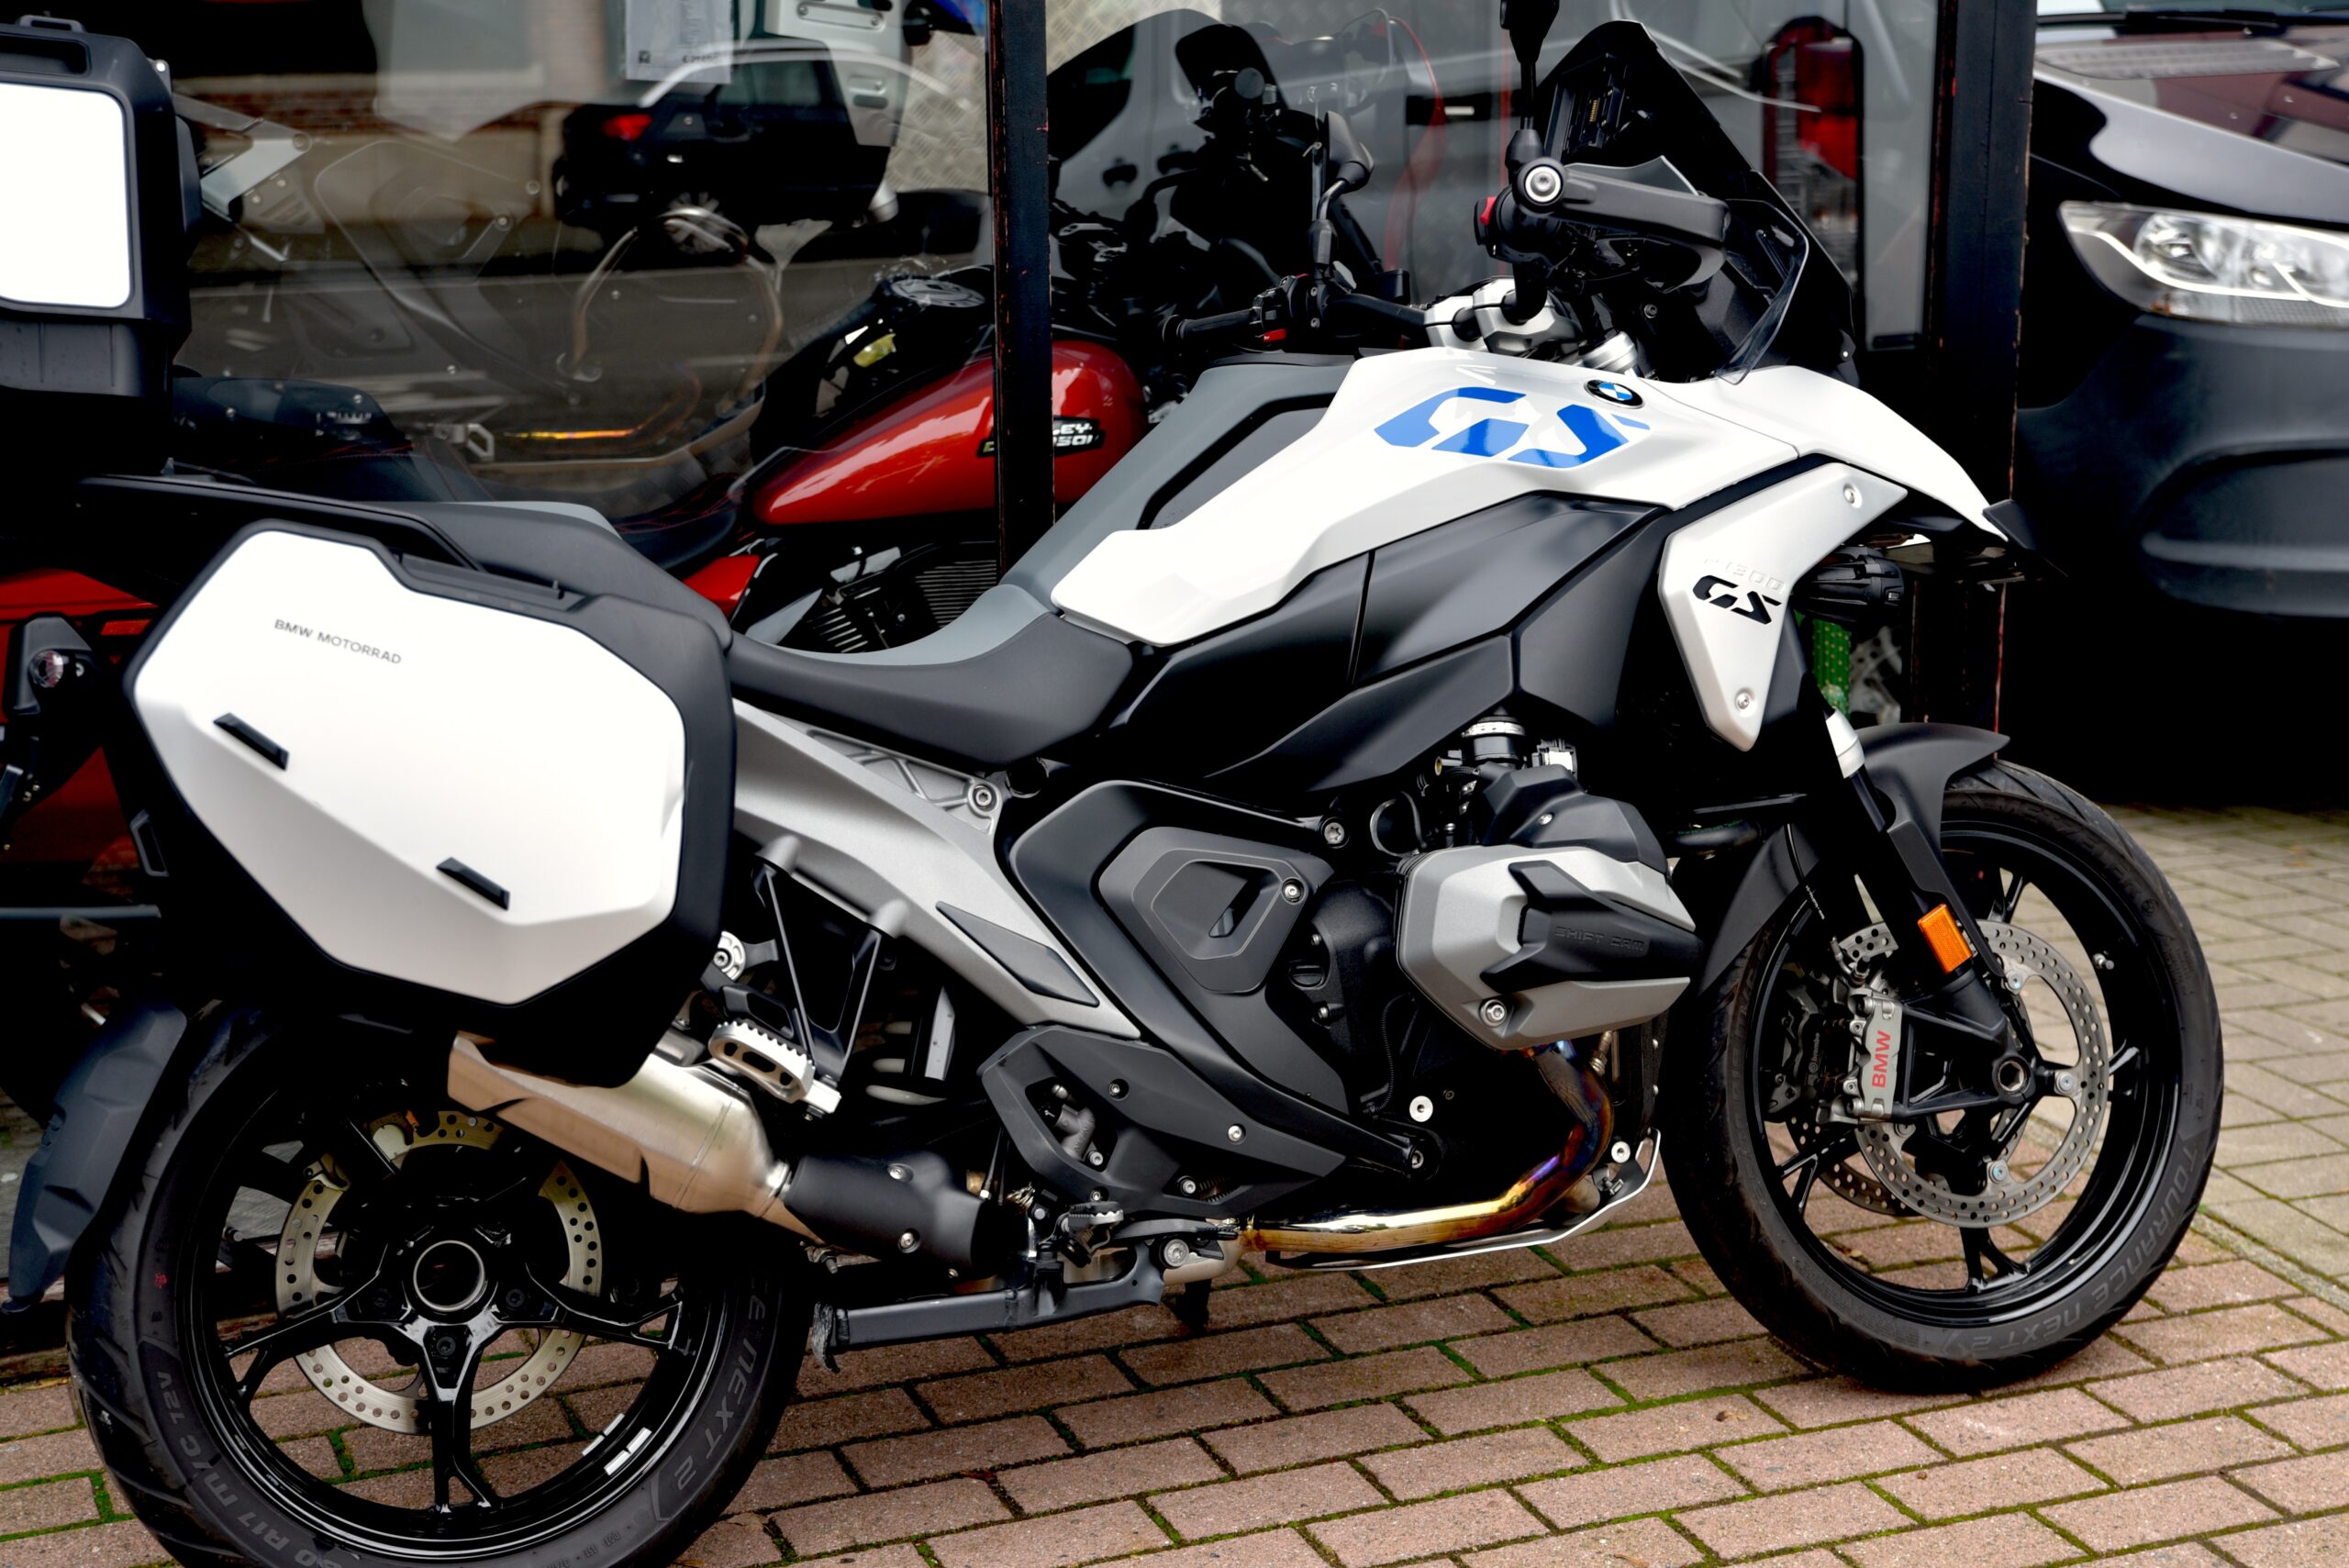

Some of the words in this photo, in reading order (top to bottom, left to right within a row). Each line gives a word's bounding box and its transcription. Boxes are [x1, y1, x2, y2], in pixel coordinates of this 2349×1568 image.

[1374, 385, 1650, 469] GS
[1692, 574, 1783, 625] GS
[273, 618, 313, 638] BMW
[317, 631, 402, 664] MOTORRAD
[1554, 924, 1604, 943] SHIFT
[1871, 1029, 1891, 1087] BMW
[2091, 1144, 2198, 1310] TOURANCE
[1969, 1335, 1993, 1352] 2
[1999, 1300, 2082, 1351] NEXT
[705, 1336, 759, 1460] NEXT
[674, 1454, 696, 1492] 2
[236, 1510, 291, 1552] R17
